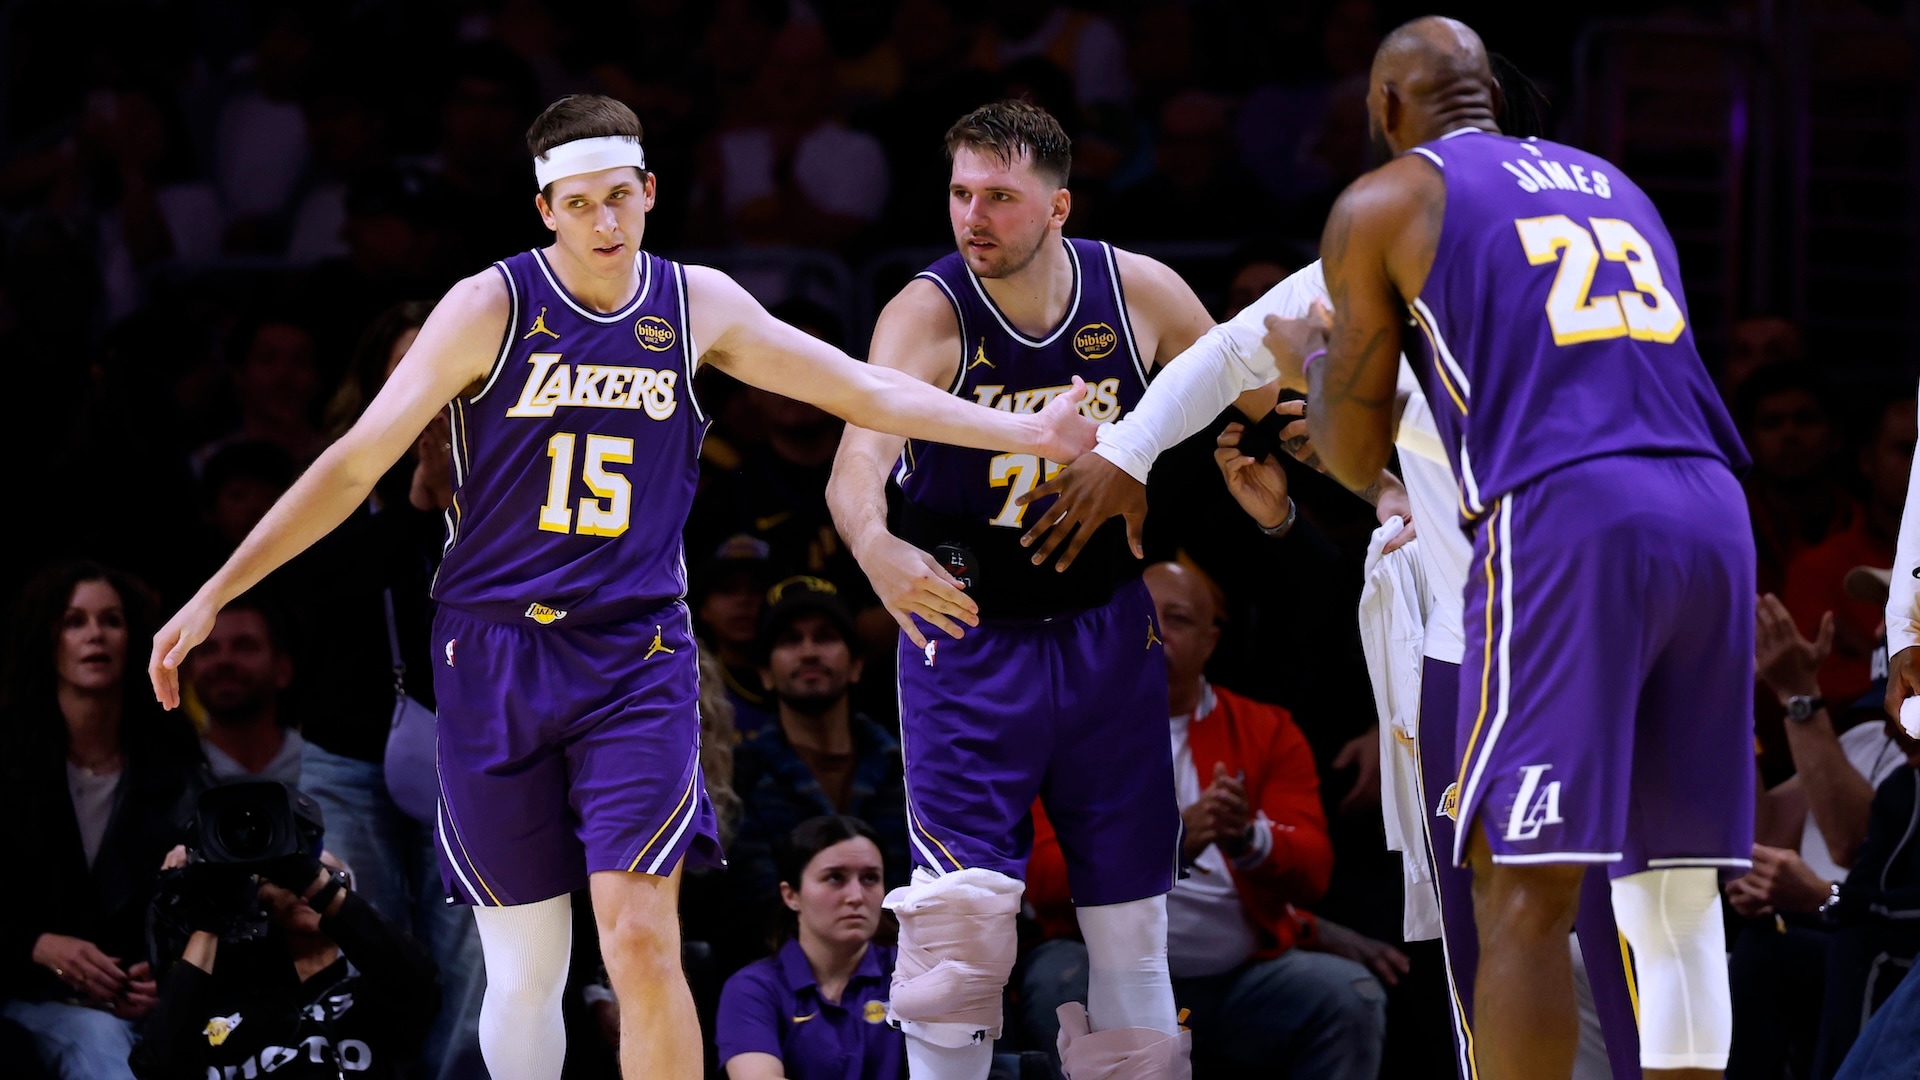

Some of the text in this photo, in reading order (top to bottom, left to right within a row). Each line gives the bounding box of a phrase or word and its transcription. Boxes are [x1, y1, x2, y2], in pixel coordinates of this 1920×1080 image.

[1501, 158, 1612, 199] JAMES
[1514, 214, 1686, 346] 23
[638, 324, 673, 343] bibigo
[1077, 332, 1114, 348] bibigo
[505, 353, 678, 421] LAKERS
[973, 377, 1121, 424] KRS
[538, 431, 634, 538] 15
[989, 453, 1068, 528] 7
[1502, 763, 1565, 841] LA
